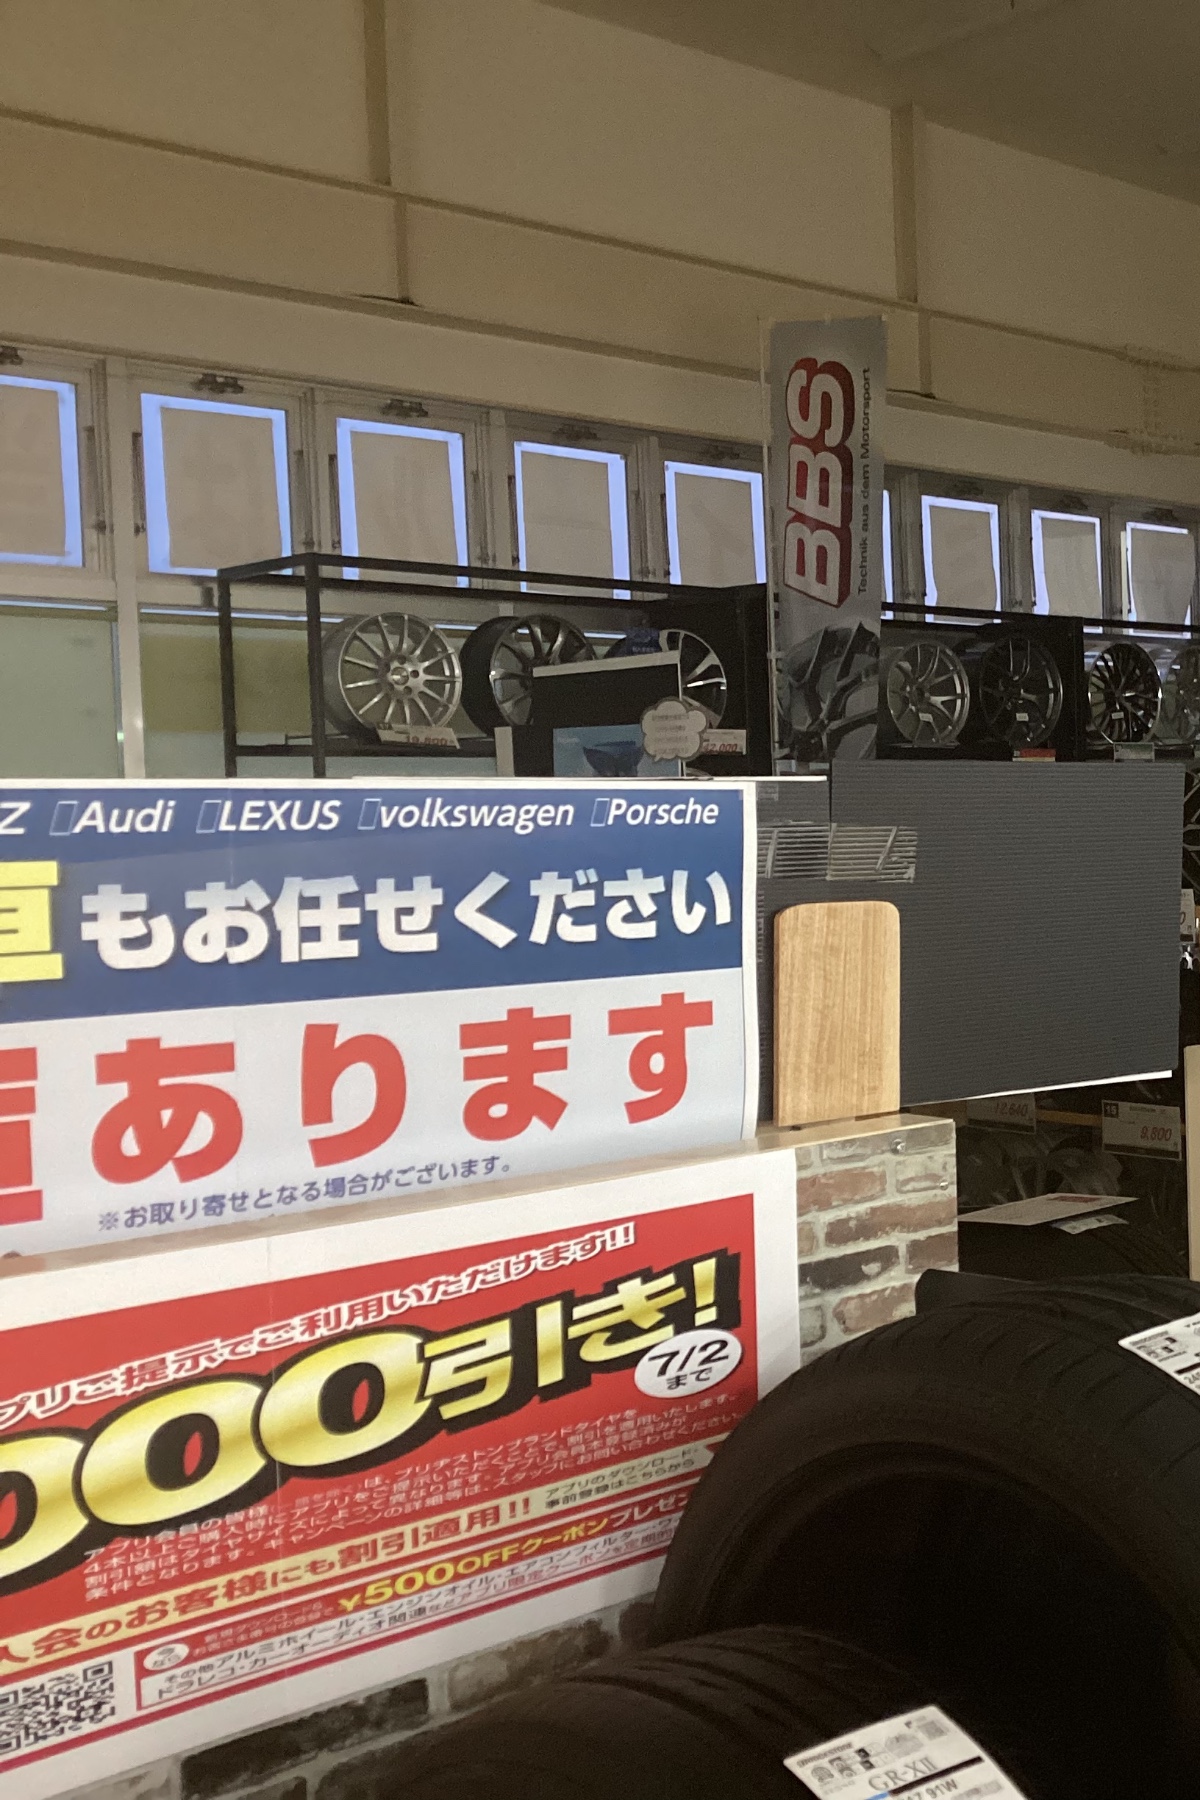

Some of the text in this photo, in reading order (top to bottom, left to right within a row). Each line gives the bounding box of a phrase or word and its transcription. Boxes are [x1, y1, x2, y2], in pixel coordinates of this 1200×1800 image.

[783, 357, 854, 608] BBS
[858, 367, 871, 596] Technik aus dem Motorsport
[72, 799, 177, 833] Audi
[218, 800, 340, 832] LEXUS
[378, 799, 575, 834] volkswagen
[606, 798, 720, 827] Porsche
[648, 1340, 729, 1376] 7/2
[666, 1369, 713, 1390] まで
